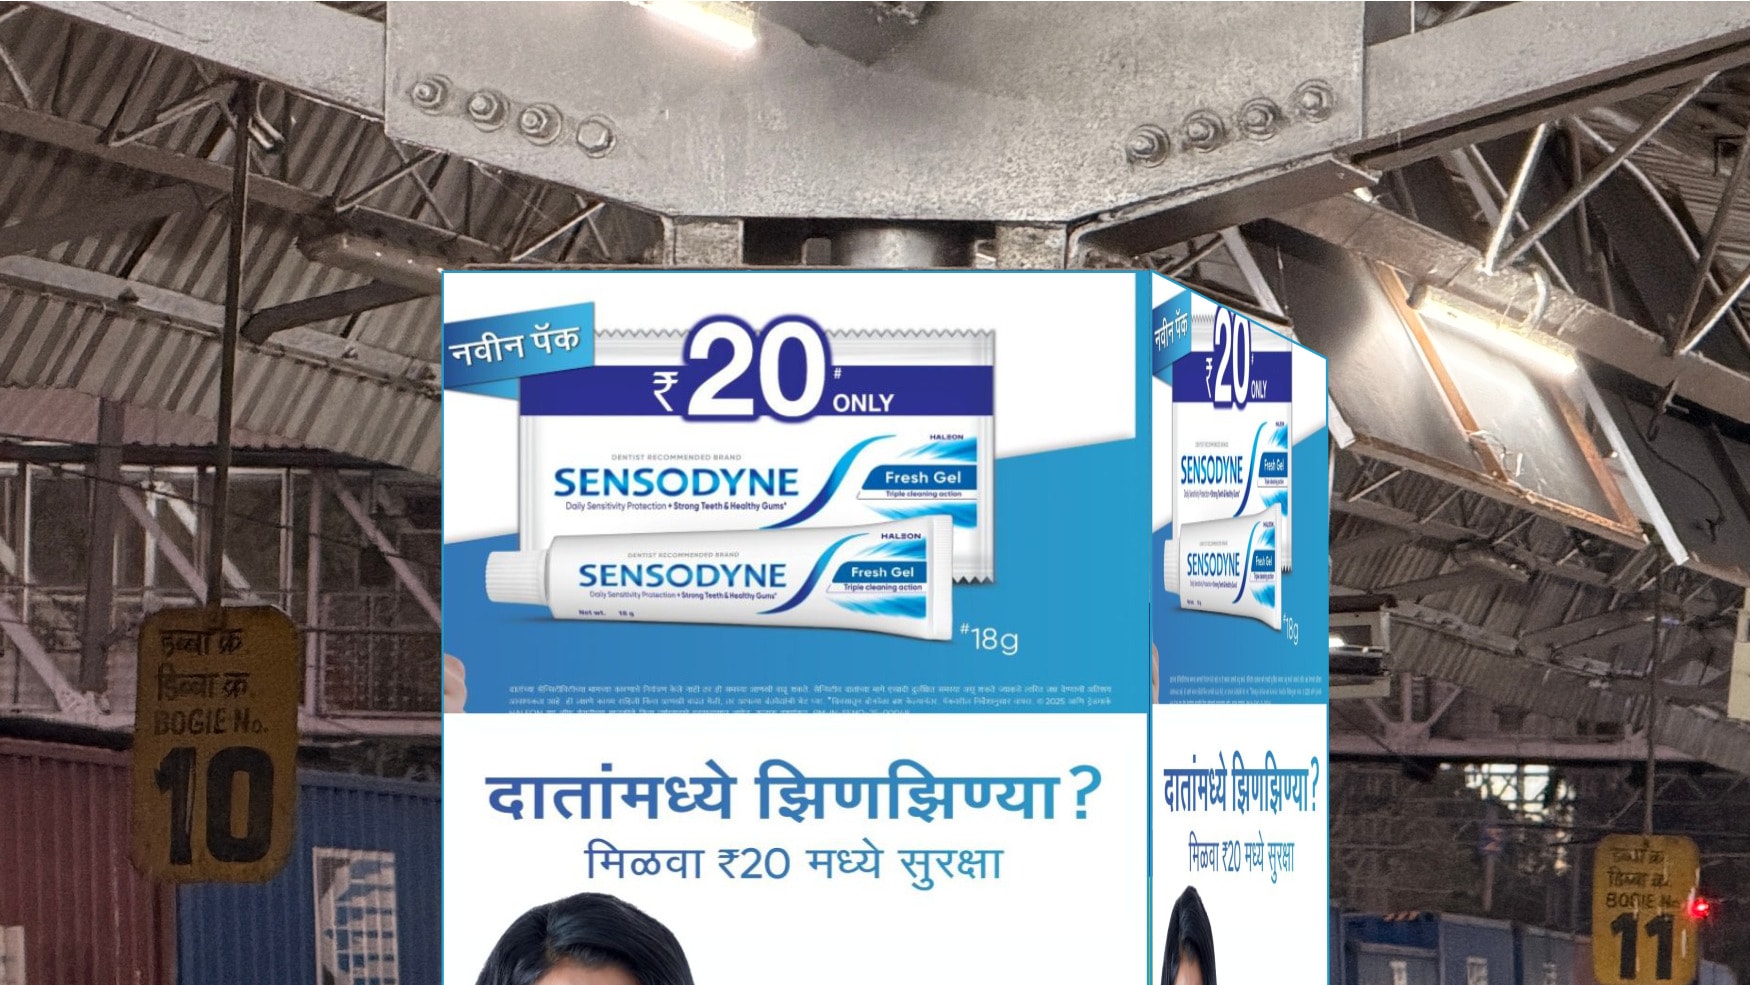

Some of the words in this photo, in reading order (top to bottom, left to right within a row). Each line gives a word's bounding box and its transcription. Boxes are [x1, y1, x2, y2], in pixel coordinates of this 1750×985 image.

[448, 331, 525, 367] नवीन
[530, 322, 581, 355] पॅक
[832, 394, 895, 412] ONLY
[1251, 380, 1268, 399] ONLY
[554, 467, 799, 497] SENSODYNE
[885, 471, 929, 484] Fresh
[933, 471, 962, 484] Gel
[1180, 455, 1243, 485] SENSODYNE
[565, 501, 585, 511] Daily
[586, 501, 625, 511] Sensitivity
[627, 501, 667, 510] Protection
[674, 501, 699, 511] Strong
[701, 501, 723, 510] Teeth
[730, 501, 760, 511] Healthy
[579, 563, 787, 588] SENSODYNE
[851, 567, 887, 577] Fresh
[891, 567, 914, 577] Gel
[1187, 552, 1240, 577] SENSODYNE
[682, 591, 704, 600] Strong
[705, 591, 724, 599] Teeth
[844, 584, 864, 592] Triple
[865, 584, 897, 592] cleaning
[154, 707, 227, 736] BOGIE
[485, 760, 737, 821] दातांमध्ये
[1163, 751, 1227, 812] दातांमध्ये
[155, 745, 275, 866] 10
[584, 838, 705, 879] मिळवा
[718, 846, 791, 879] ₹20
[805, 837, 884, 879] मध्ये
[897, 847, 1004, 891] सुरक्षा
[1189, 830, 1219, 872] मिळवा
[1222, 840, 1241, 872] ₹20
[1244, 830, 1264, 872] मध्ये
[1268, 842, 1295, 884] सुरक्षा
[1606, 892, 1654, 908] BOGIE
[1610, 912, 1675, 980] 11
